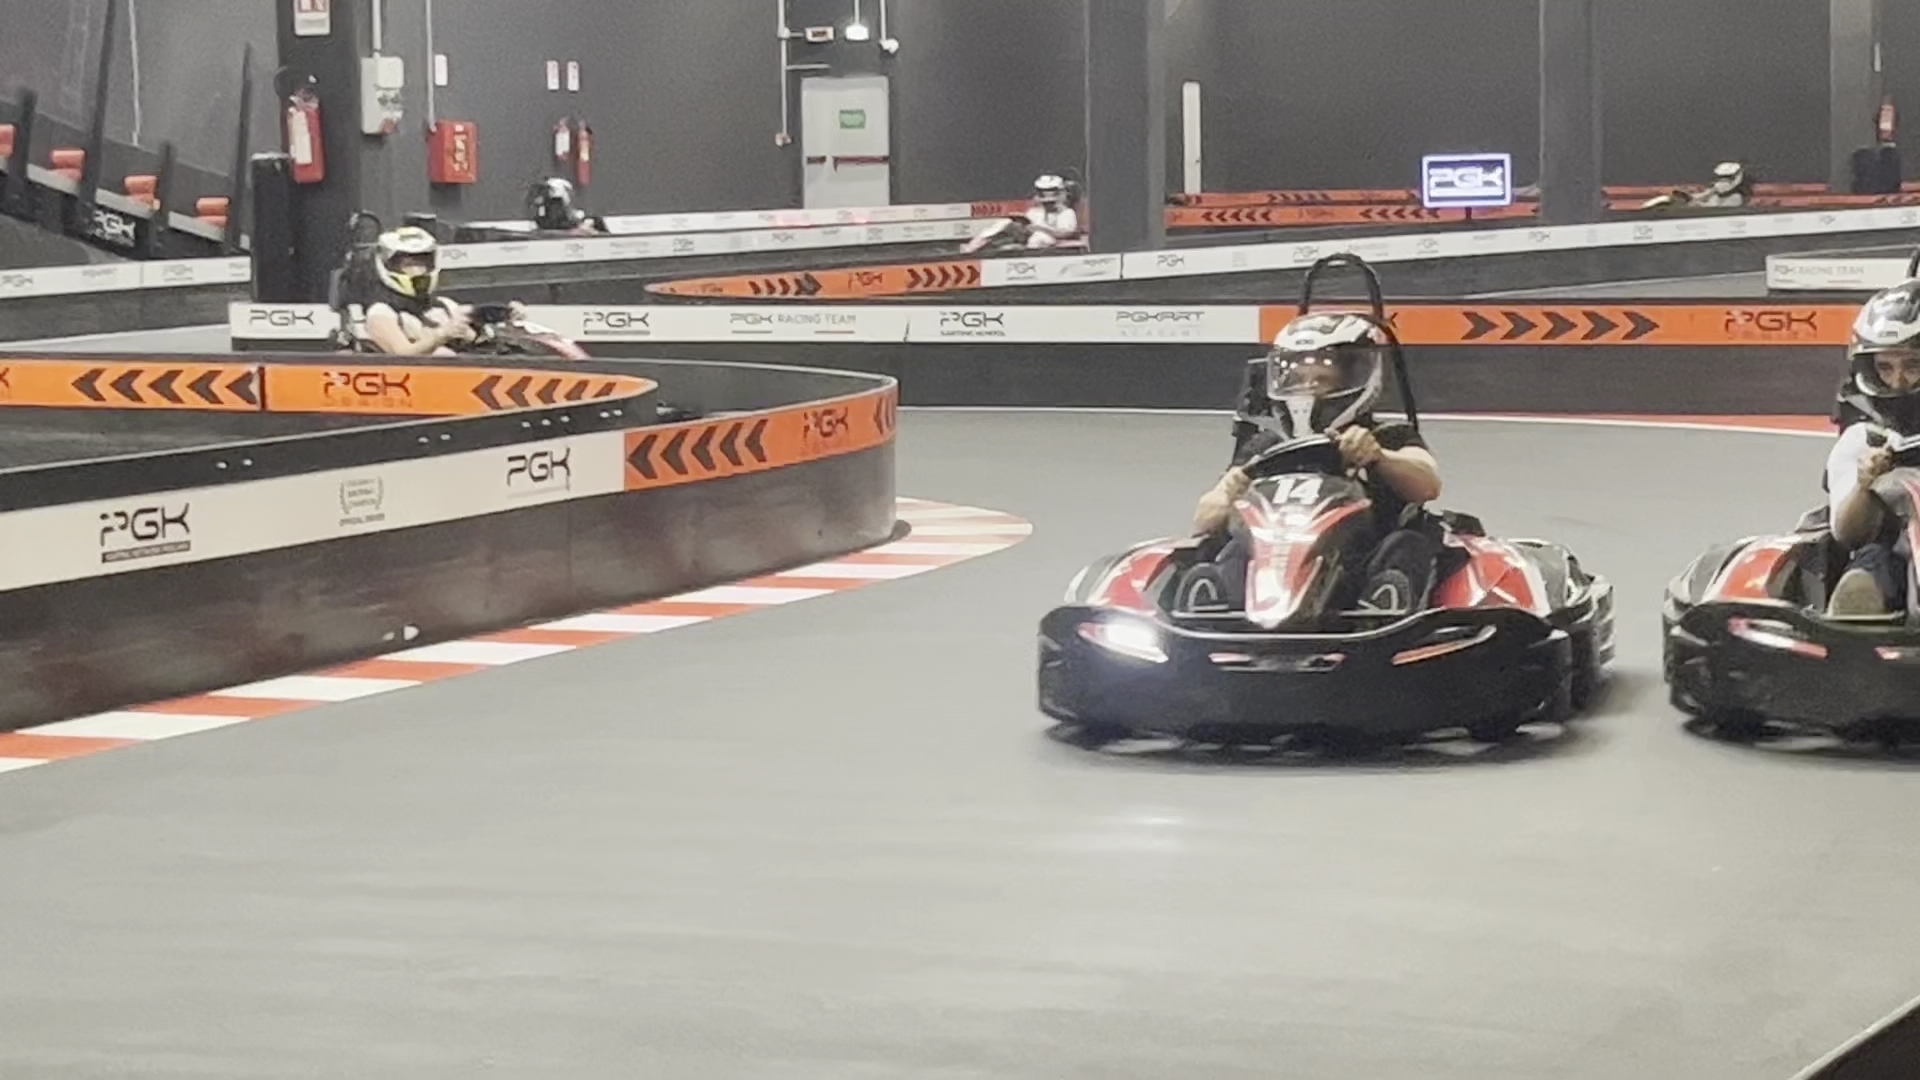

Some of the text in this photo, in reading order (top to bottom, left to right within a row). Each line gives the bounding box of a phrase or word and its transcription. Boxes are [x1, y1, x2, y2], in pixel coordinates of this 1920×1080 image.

[1429, 166, 1504, 190] PGK
[249, 310, 315, 327] PGK
[583, 312, 650, 328] PGK
[730, 313, 857, 325] PGK RACING TEAM
[940, 311, 1004, 328] PGK
[1724, 311, 1818, 332] PGK
[322, 371, 411, 397] PGK
[803, 406, 849, 439] PGK
[507, 447, 571, 491] PGK
[1271, 477, 1324, 505] 14
[99, 502, 190, 547] PGK
